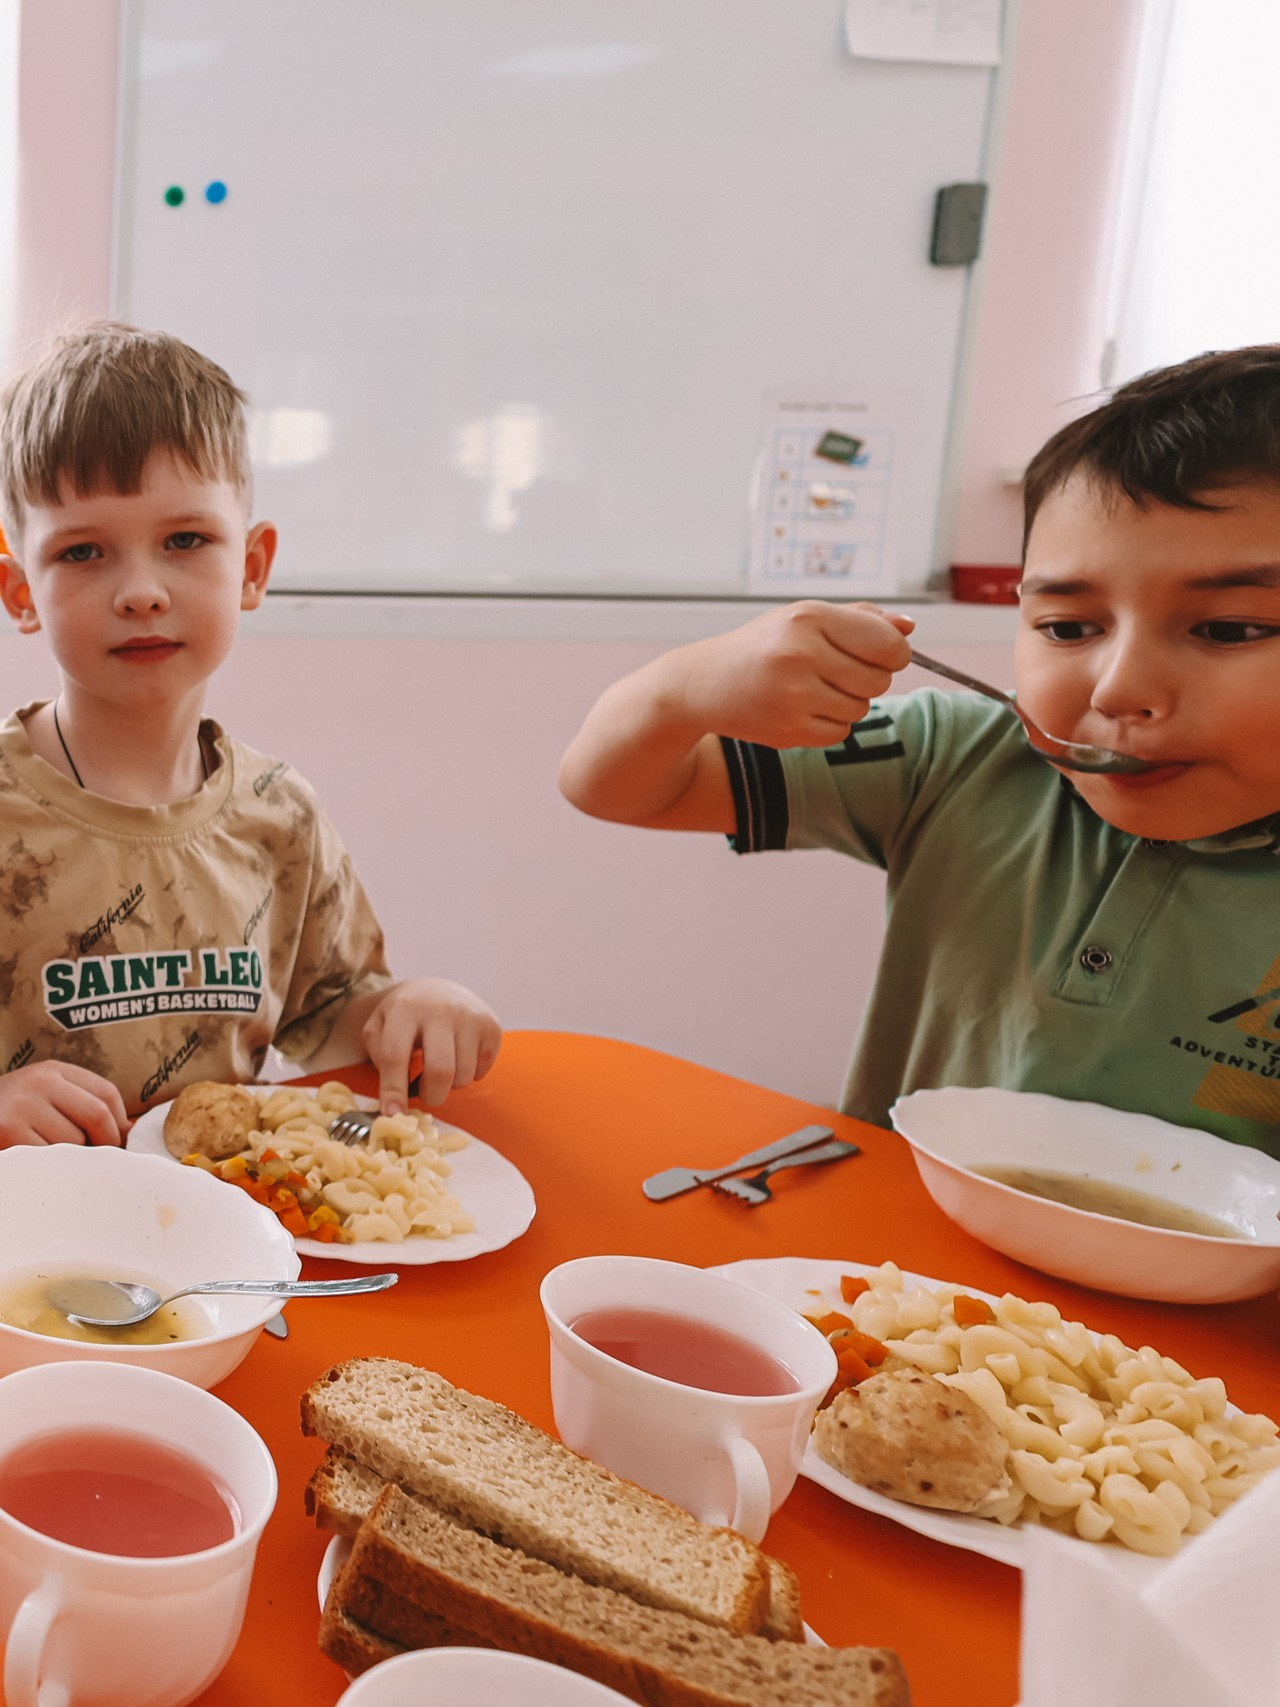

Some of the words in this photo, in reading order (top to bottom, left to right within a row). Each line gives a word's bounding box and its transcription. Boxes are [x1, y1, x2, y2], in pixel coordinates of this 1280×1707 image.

[80, 882, 146, 953] California
[45, 954, 188, 1005] SAINT
[203, 950, 262, 988] LEO
[70, 998, 155, 1025] WOMEN'S
[158, 993, 257, 1010] BASKETBALL
[141, 1030, 202, 1103] California
[1170, 1036, 1280, 1079] ADVENTU
